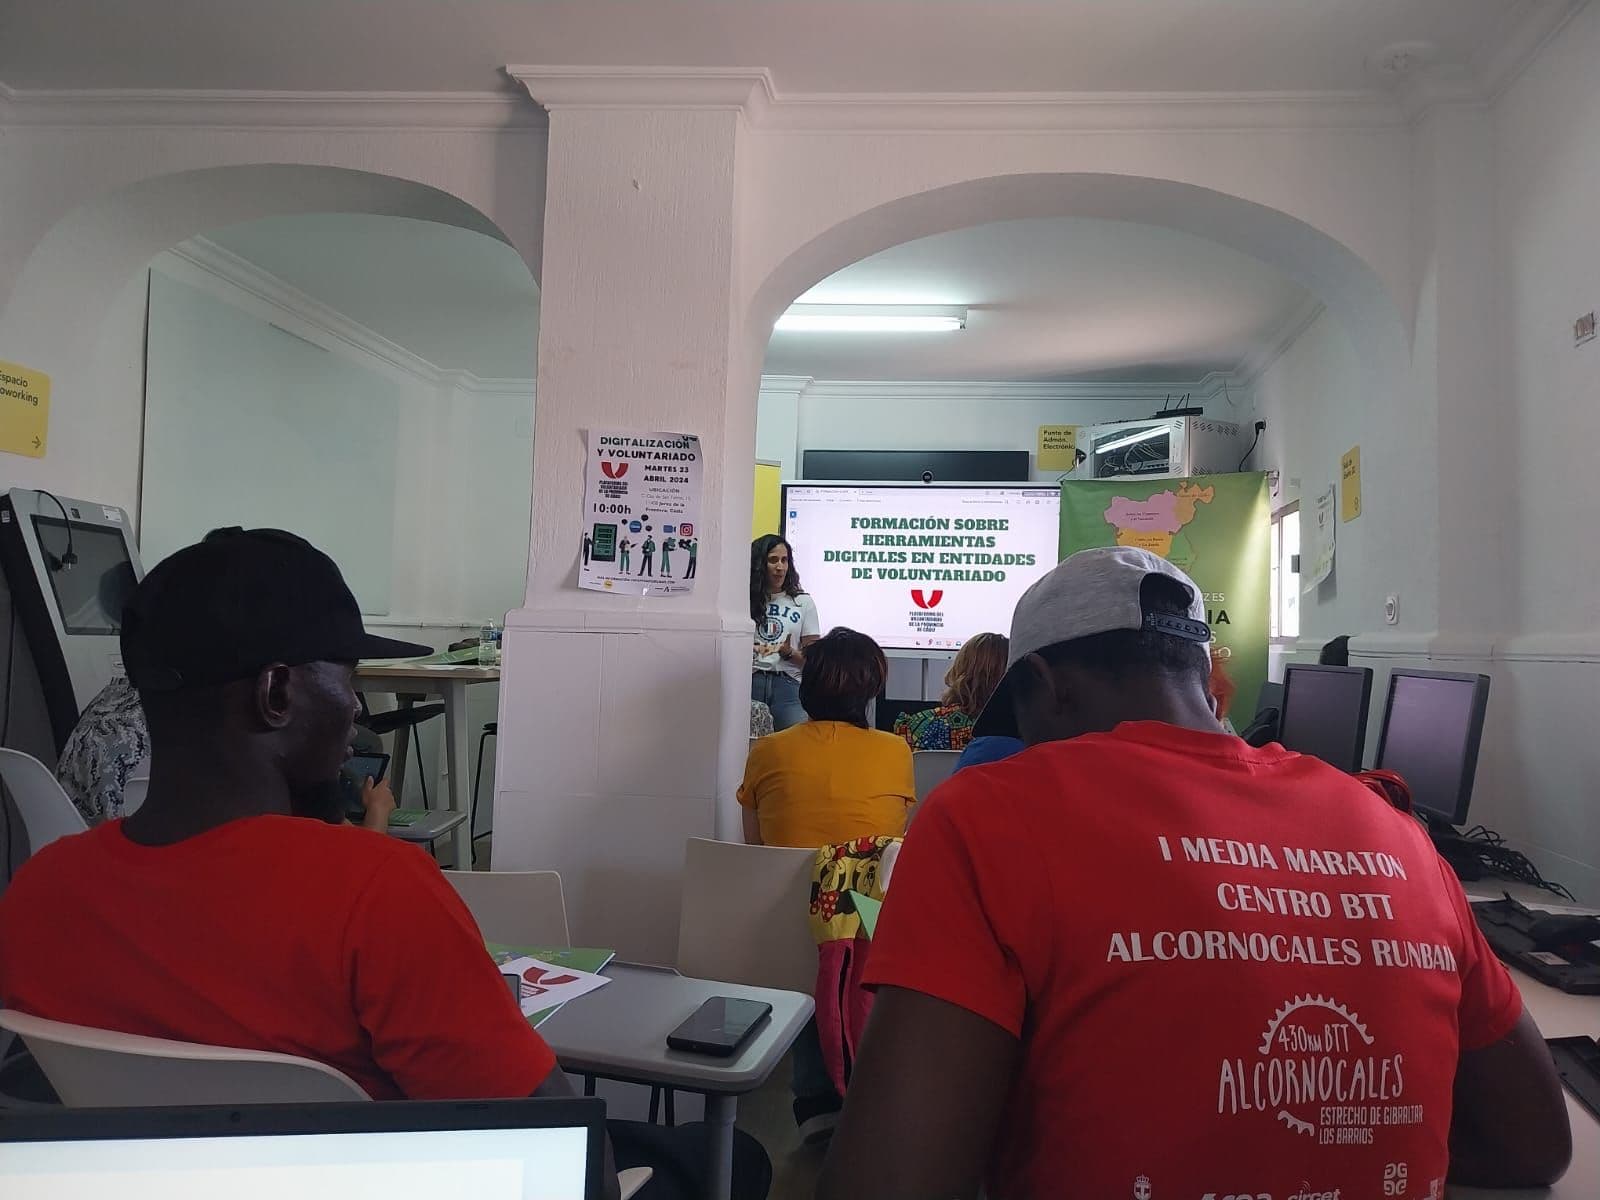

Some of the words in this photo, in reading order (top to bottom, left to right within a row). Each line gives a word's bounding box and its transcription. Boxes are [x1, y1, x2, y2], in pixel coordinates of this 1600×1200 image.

[597, 448, 604, 457] Y
[608, 449, 696, 461] VOLUNTARIADO
[644, 464, 677, 473] MARTES
[593, 503, 632, 514] 10:00h
[851, 515, 950, 530] FORMACIÓN
[954, 518, 1009, 531] SOBRE
[862, 534, 996, 548] HERRAMIENTAS
[823, 550, 907, 564] DIGITALES
[911, 552, 935, 564] EN
[939, 552, 1036, 566] ENTIDADES
[851, 567, 872, 580] DE
[878, 568, 1006, 582] VOLUNTARIADO
[1157, 836, 1173, 861] I
[1180, 837, 1279, 870] MEDIA
[1281, 846, 1408, 881] MARATON
[1217, 882, 1332, 918] CENTRO
[1340, 893, 1394, 920] BTT
[1106, 931, 1362, 966] ALCORNOCALES
[1324, 1023, 1349, 1052] BTT
[1217, 1053, 1404, 1115] ALCORNOCALES
[1320, 1106, 1367, 1126] ESTRECHO
[1370, 1106, 1381, 1125] DE
[1383, 1104, 1424, 1125] GIBRALTAR
[1319, 1127, 1335, 1144] LOS
[1336, 1127, 1374, 1144] BARRIOS
